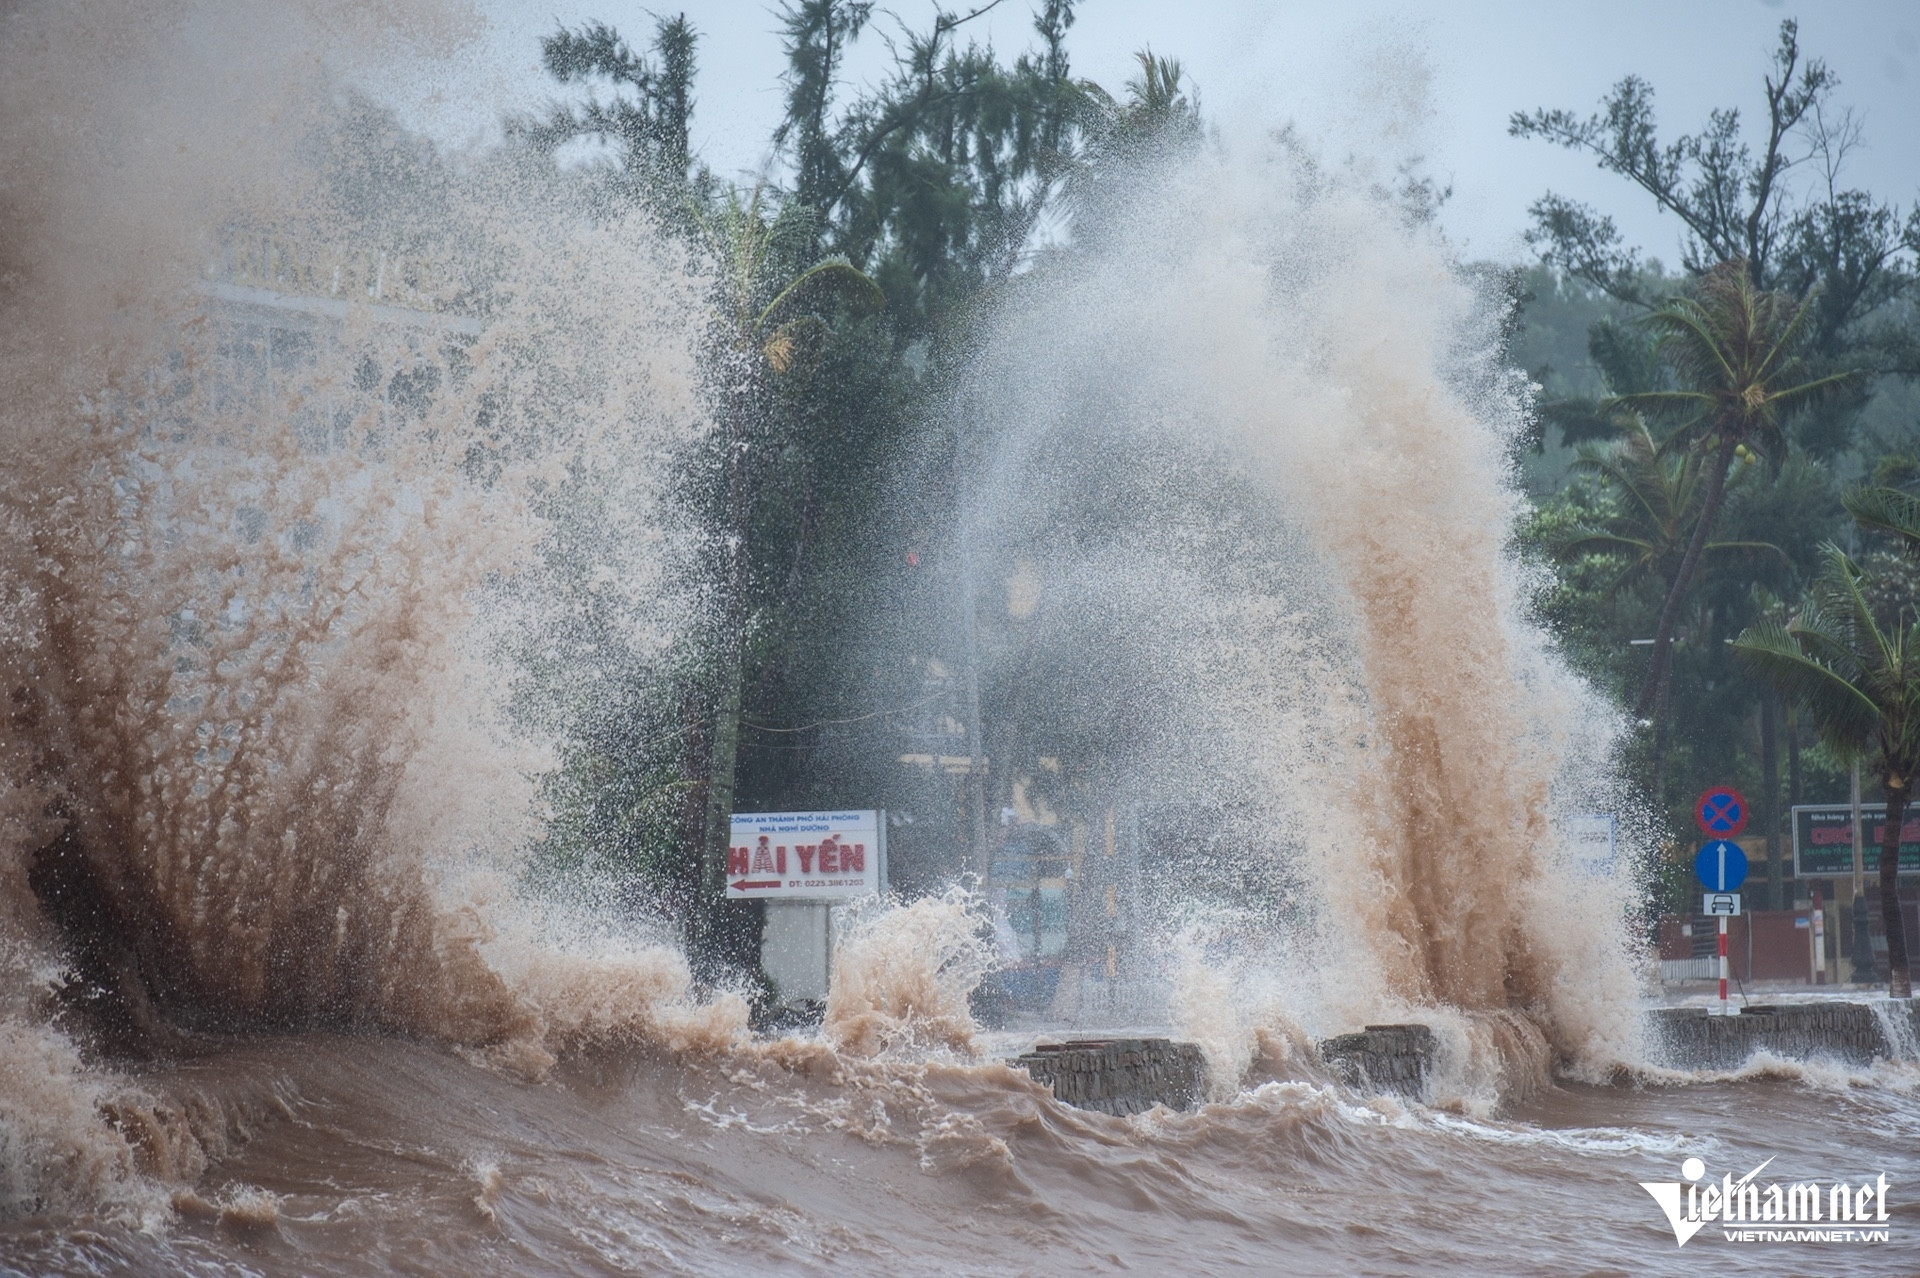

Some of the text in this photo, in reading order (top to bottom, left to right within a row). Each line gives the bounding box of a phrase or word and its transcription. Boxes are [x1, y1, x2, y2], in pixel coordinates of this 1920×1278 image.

[769, 815, 795, 823] THÀNH
[728, 833, 865, 875] HẢI YẾN
